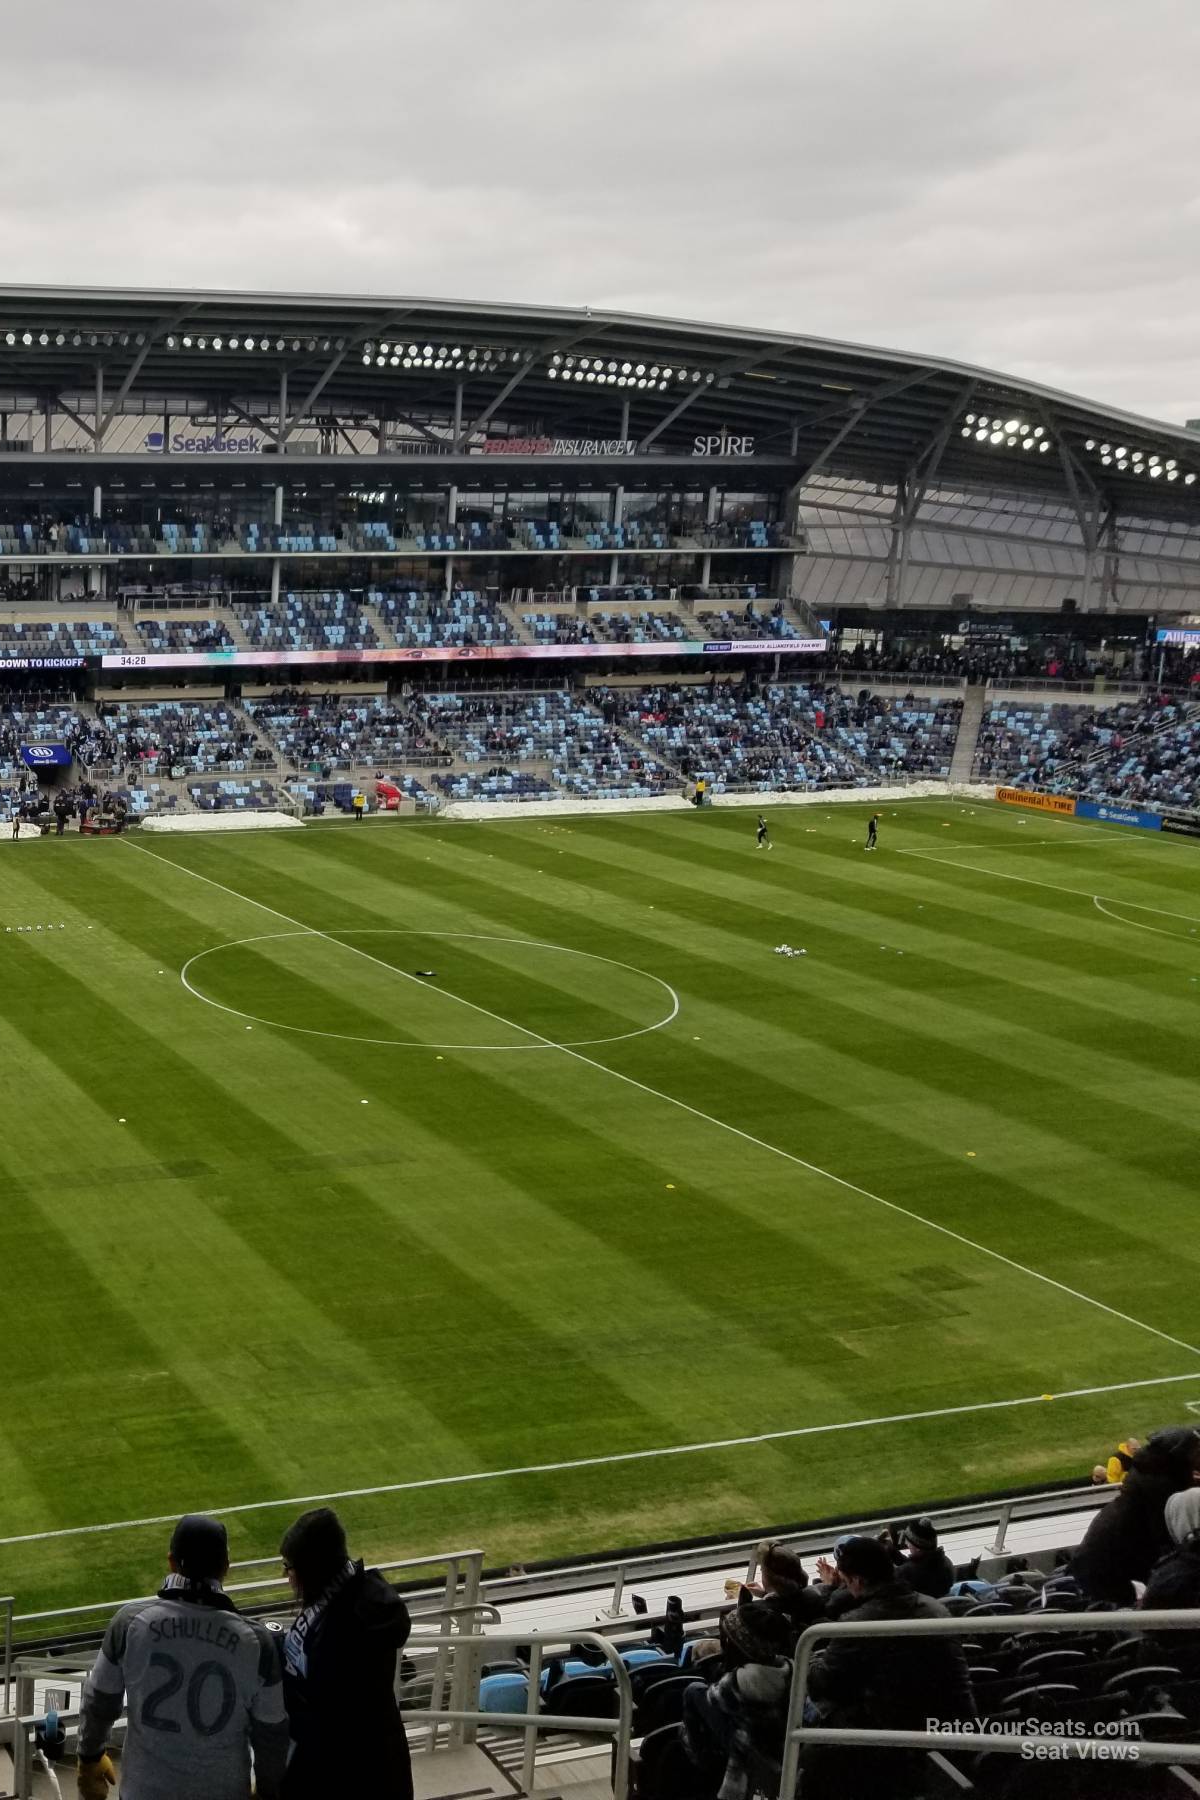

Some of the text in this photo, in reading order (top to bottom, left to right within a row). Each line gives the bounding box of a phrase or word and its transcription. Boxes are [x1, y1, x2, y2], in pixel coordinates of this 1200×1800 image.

[173, 433, 260, 452] SeatGeek
[553, 439, 625, 456] INSURANCE
[692, 433, 755, 456] SPIRE
[29, 659, 43, 667] TO
[120, 656, 146, 666] 34:28
[998, 788, 1073, 811] Continental TIRE
[148, 1617, 241, 1655] SCHULLER
[141, 1651, 237, 1737] 20
